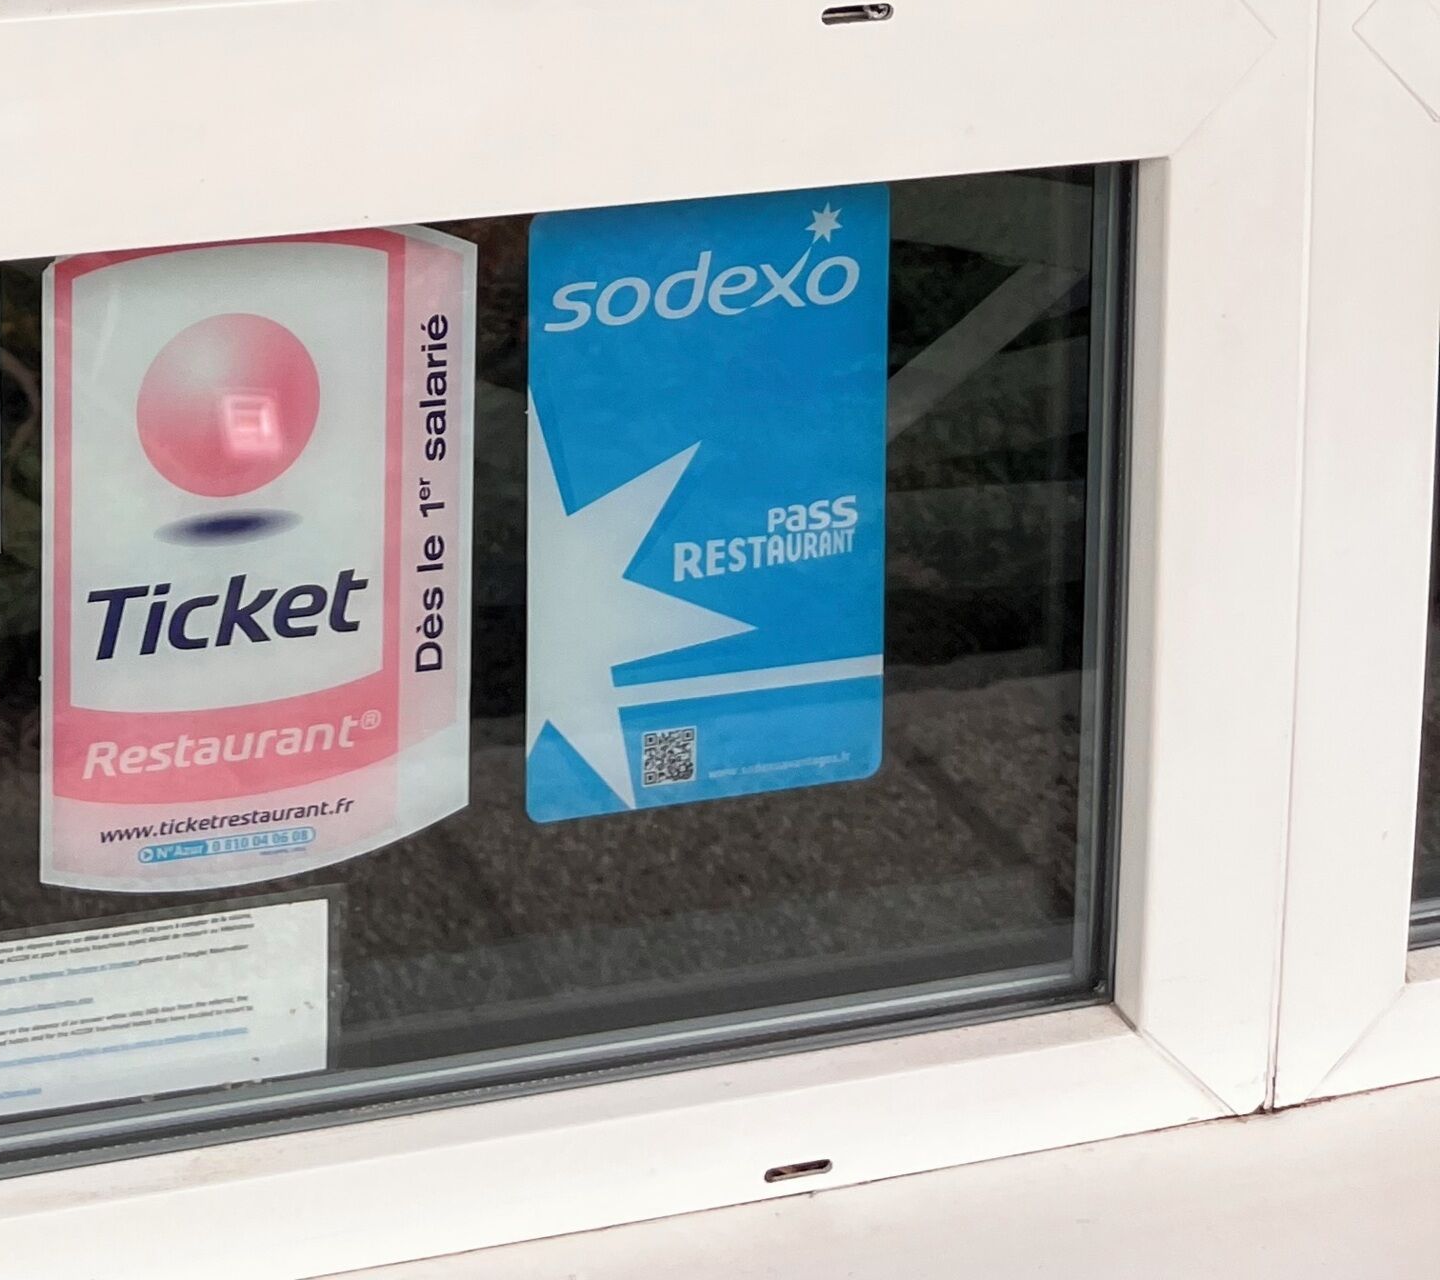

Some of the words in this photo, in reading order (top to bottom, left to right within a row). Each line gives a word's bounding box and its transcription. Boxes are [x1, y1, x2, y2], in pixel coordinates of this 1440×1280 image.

[544, 250, 860, 332] sodexo
[420, 314, 449, 462] salarié
[417, 533, 444, 572] le
[673, 528, 855, 582] RESTAURANT
[87, 568, 369, 662] Ticket
[415, 594, 443, 673] Dès
[100, 797, 354, 844] www.ticketrestaurant.fr
